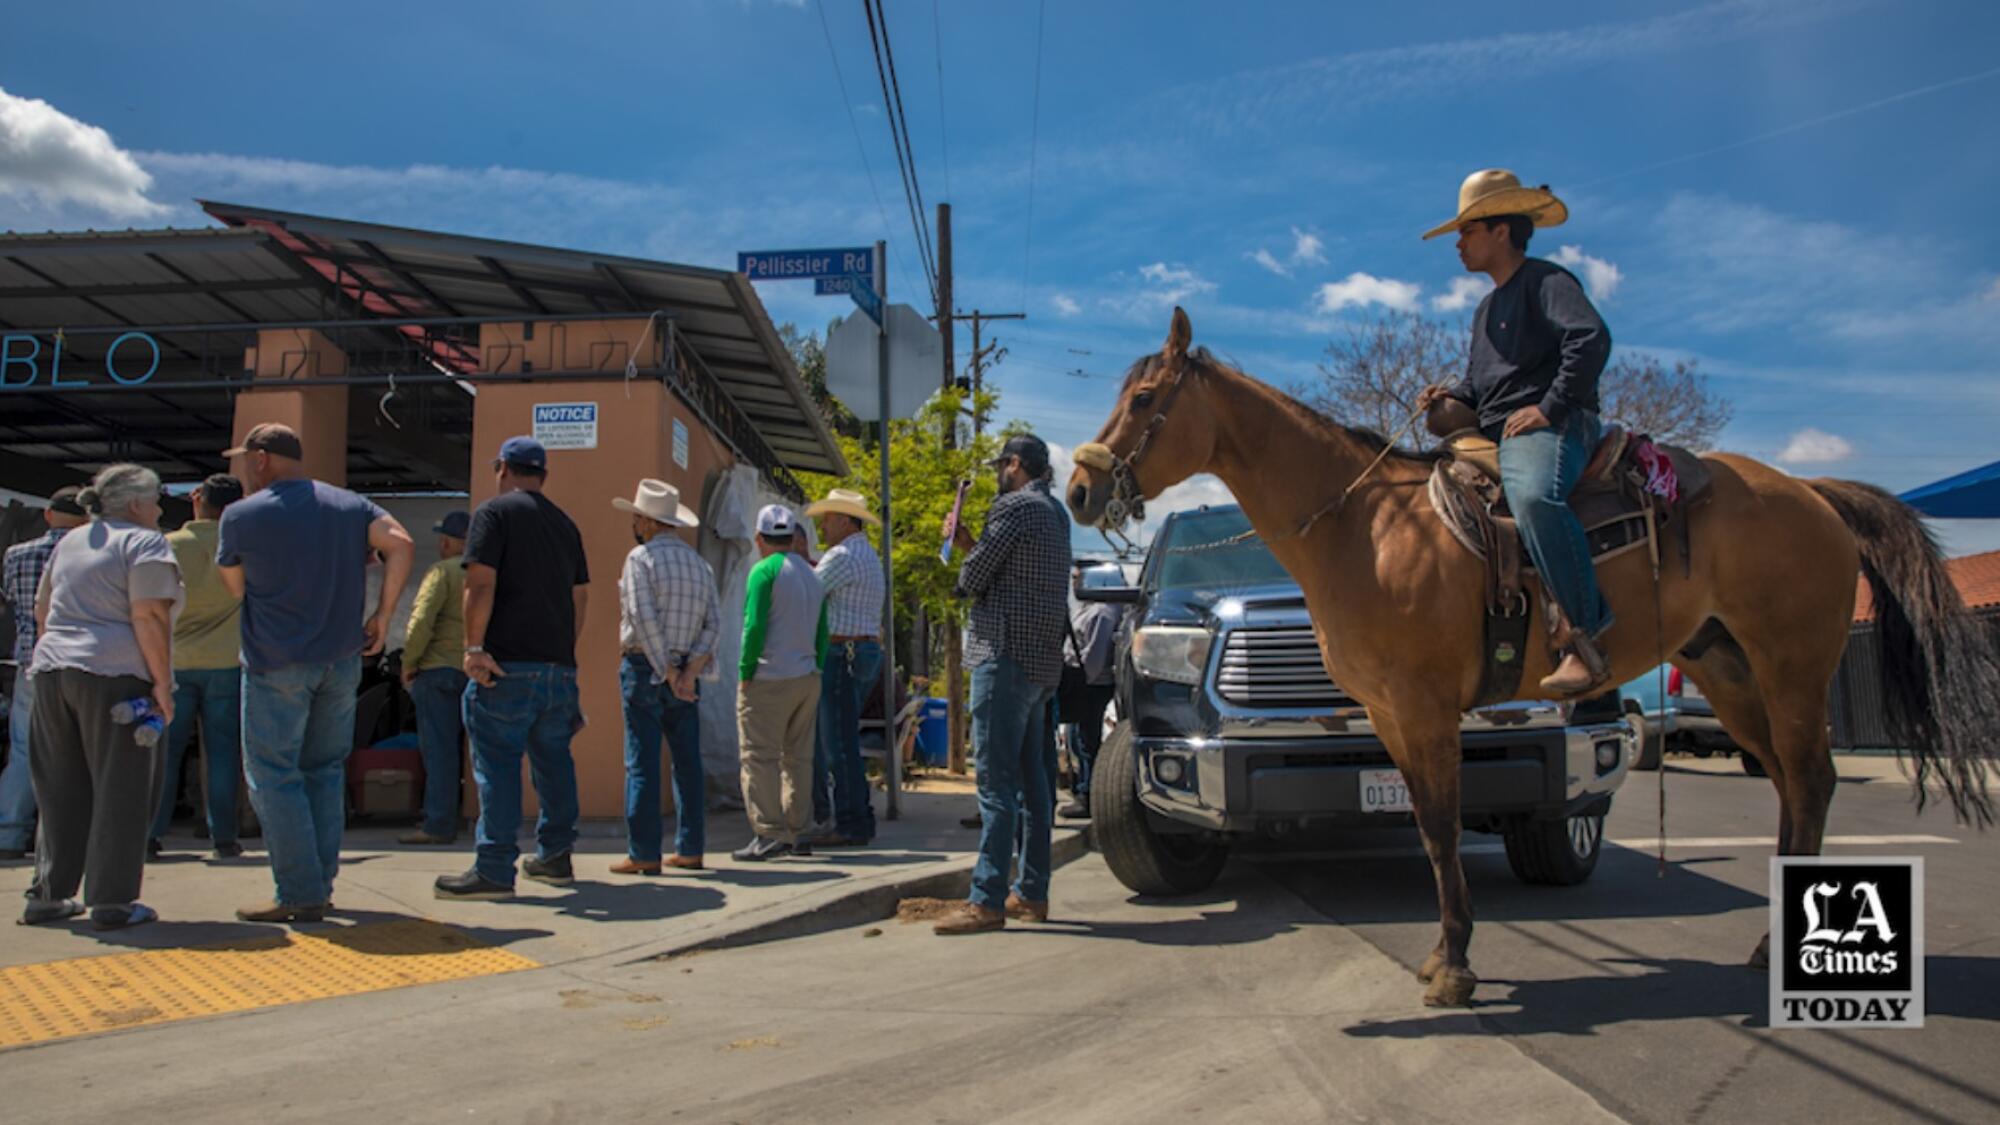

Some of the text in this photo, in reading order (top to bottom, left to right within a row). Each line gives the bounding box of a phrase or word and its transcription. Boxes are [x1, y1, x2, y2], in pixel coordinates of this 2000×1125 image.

[745, 252, 867, 276] Pellissier Rd
[537, 407, 593, 421] NOTICE
[1366, 785, 1413, 805] 0137
